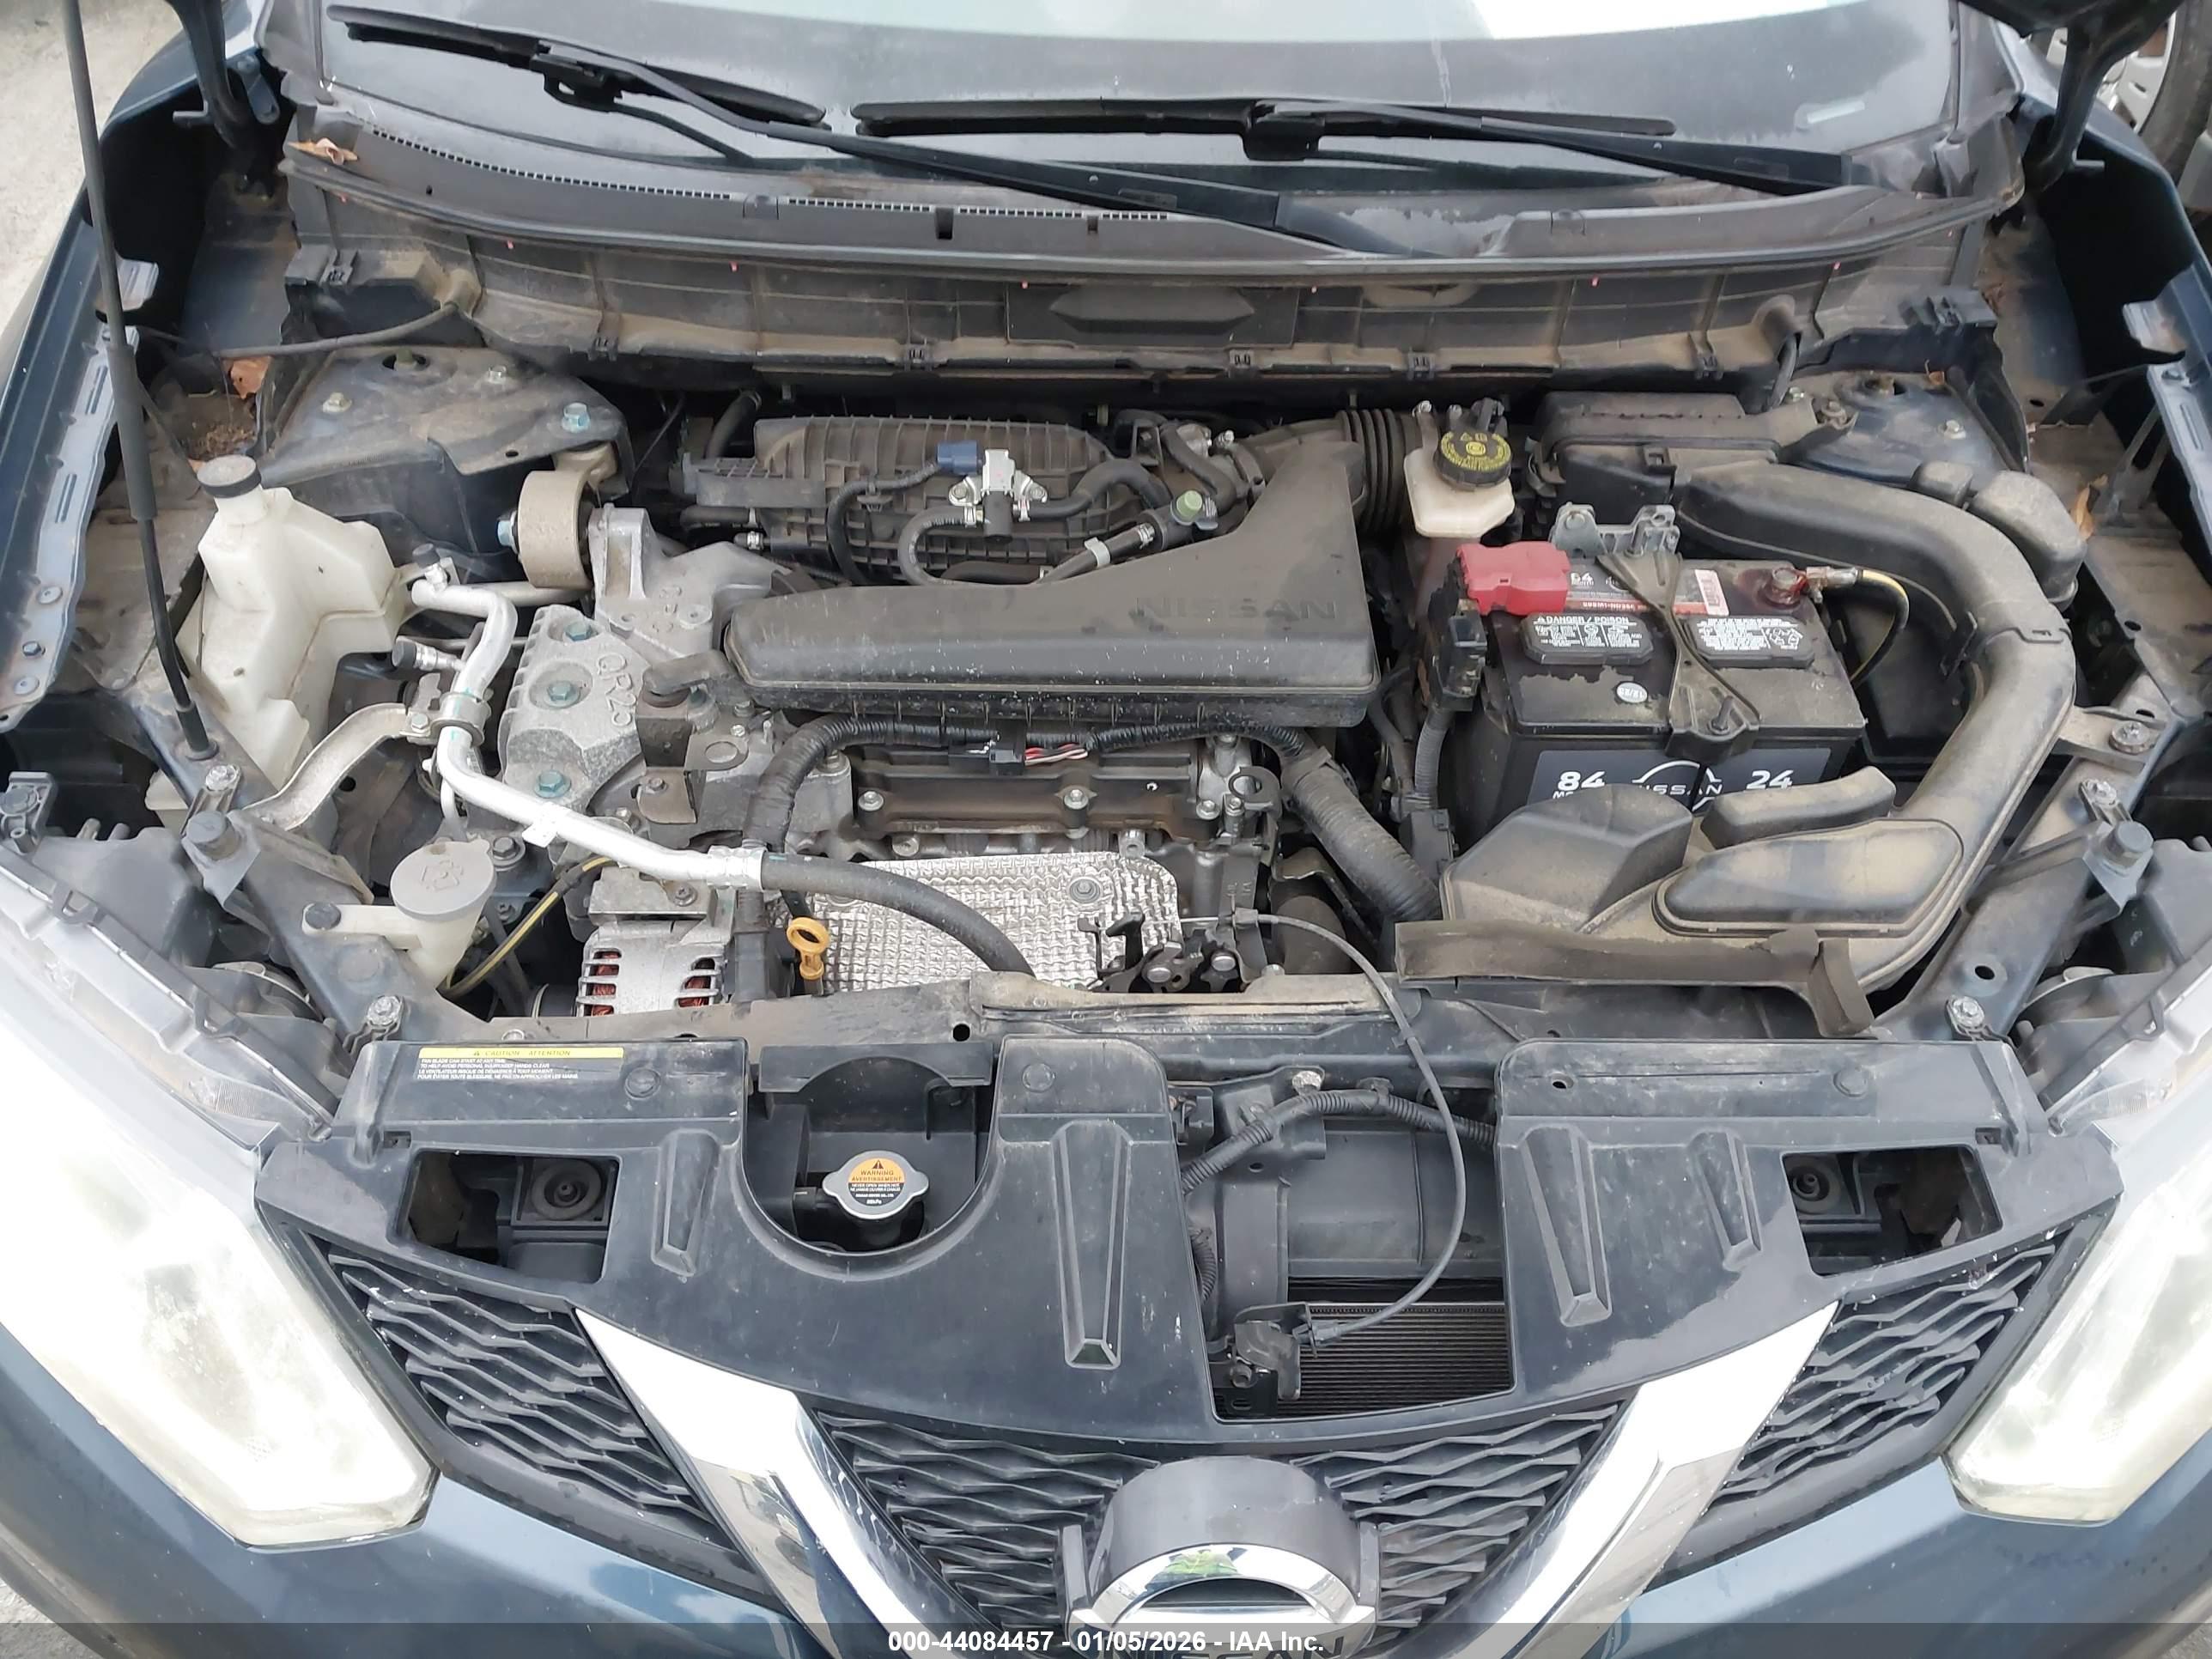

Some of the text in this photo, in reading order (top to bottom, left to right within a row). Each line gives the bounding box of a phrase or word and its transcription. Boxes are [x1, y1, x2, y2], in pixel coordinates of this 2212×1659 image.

[1134, 597, 1337, 620] NISSAN
[1546, 616, 1584, 624] DANGER
[1594, 616, 1630, 624] POISON
[1557, 769, 1795, 792] 84 24
